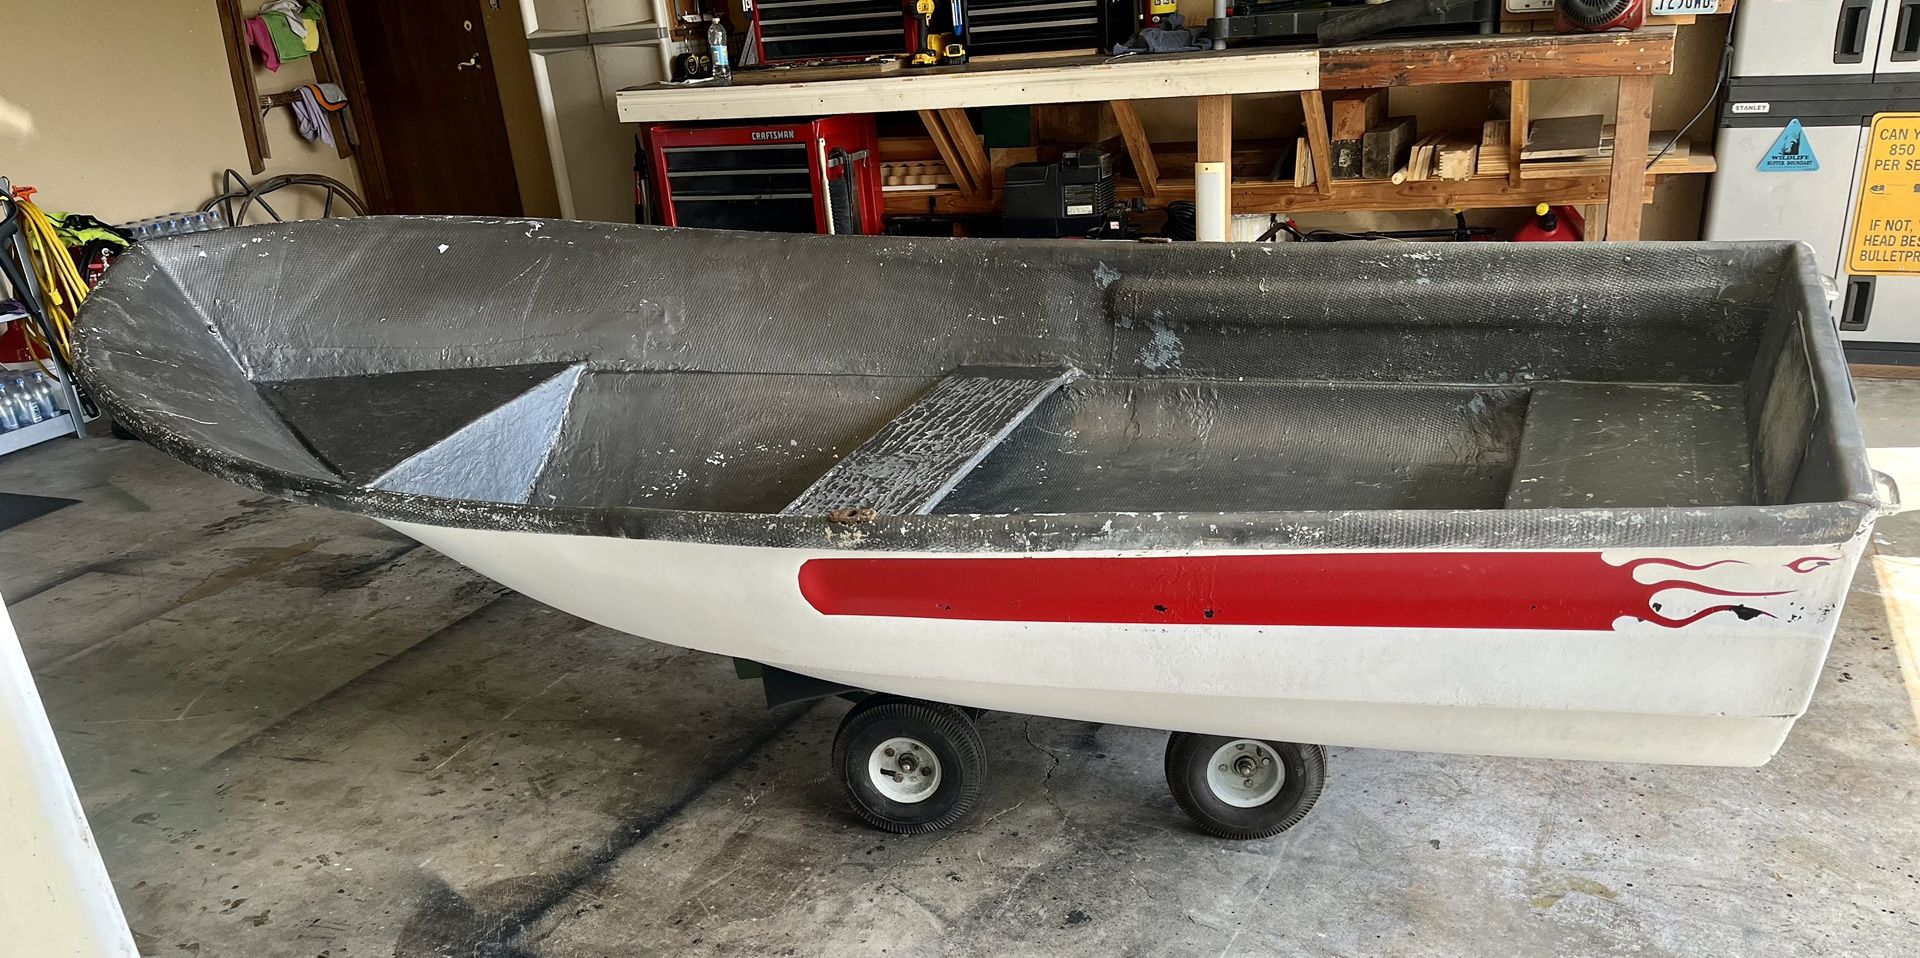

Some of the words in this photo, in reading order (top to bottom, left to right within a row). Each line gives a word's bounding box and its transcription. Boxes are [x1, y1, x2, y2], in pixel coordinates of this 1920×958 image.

[752, 130, 794, 140] CRAFTSMAN
[1880, 128, 1908, 140] CAN
[1889, 144, 1915, 155] 850
[1874, 159, 1900, 171] PER
[1905, 159, 1920, 171] SE
[1870, 219, 1881, 231] IF
[1885, 219, 1913, 232] NOT,
[1864, 235, 1896, 246] HEAD
[1860, 250, 1920, 262] BULLETPR
